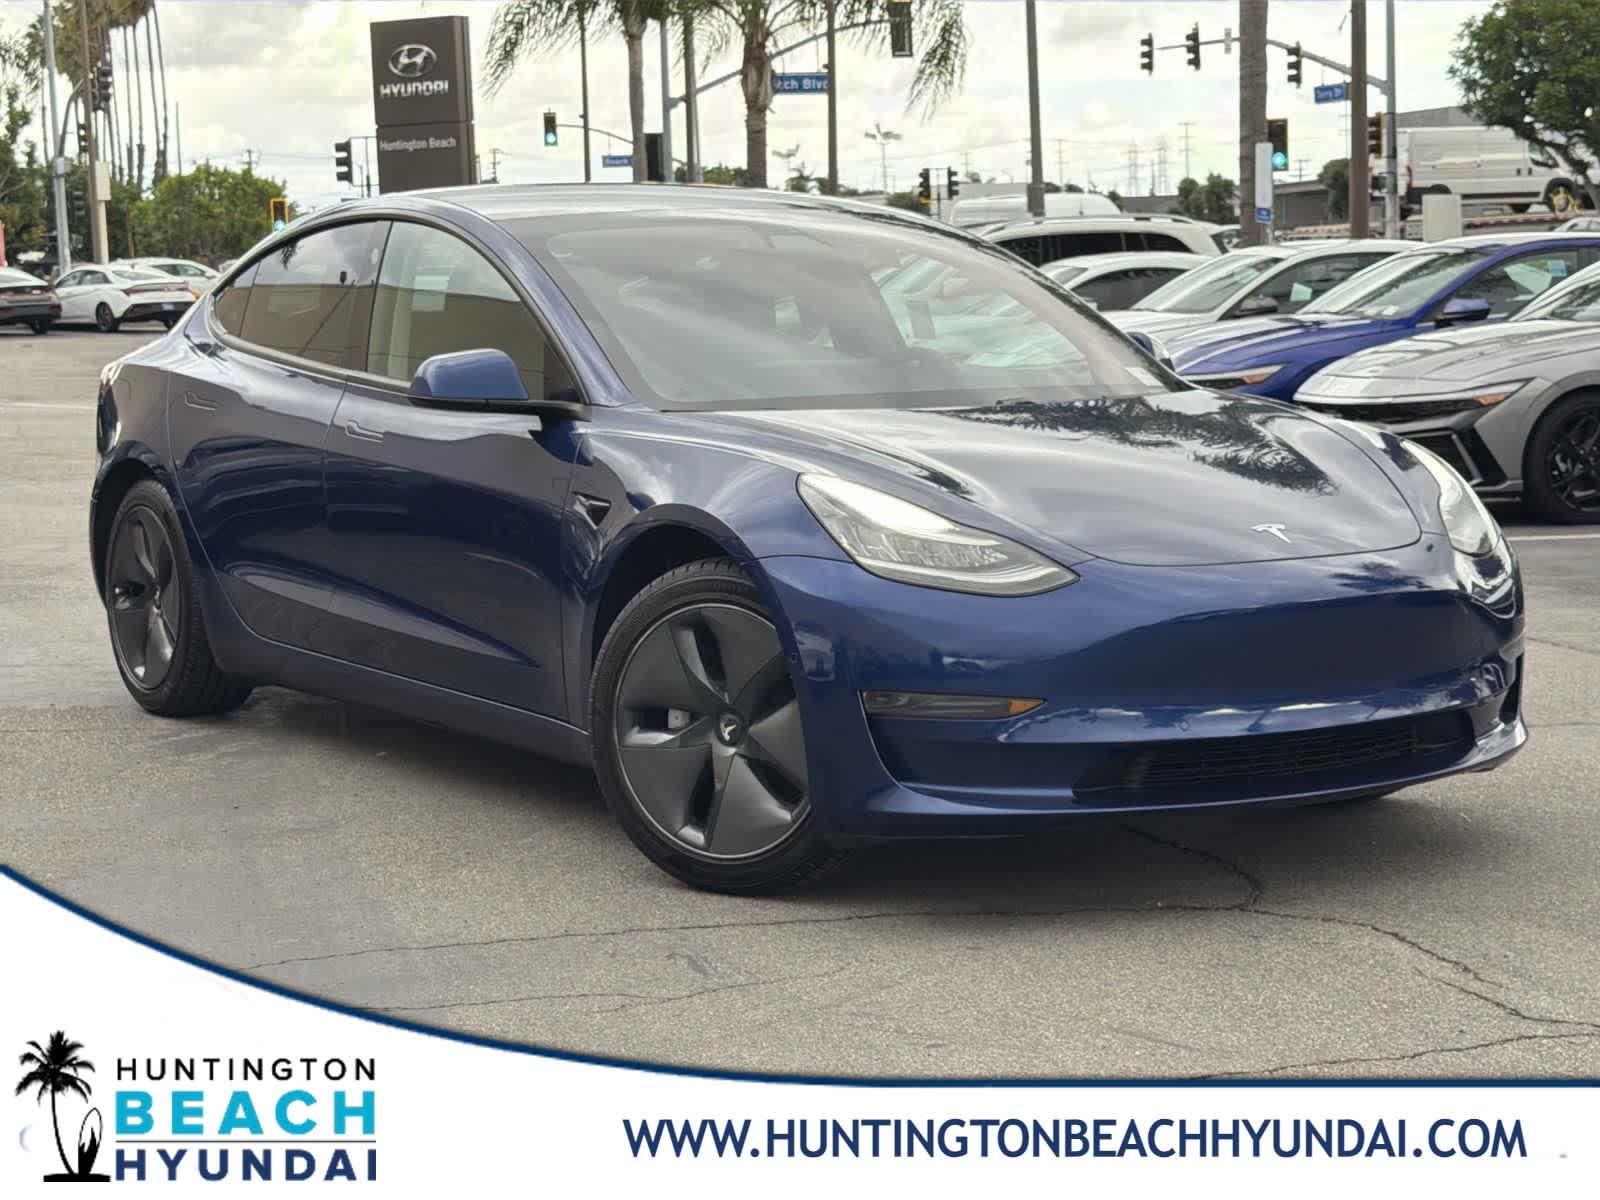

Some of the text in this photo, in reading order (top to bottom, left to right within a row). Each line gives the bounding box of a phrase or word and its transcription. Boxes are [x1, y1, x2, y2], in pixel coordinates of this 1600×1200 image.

[380, 80, 449, 98] HYUNDAI
[380, 137, 457, 152] Huntington Beach
